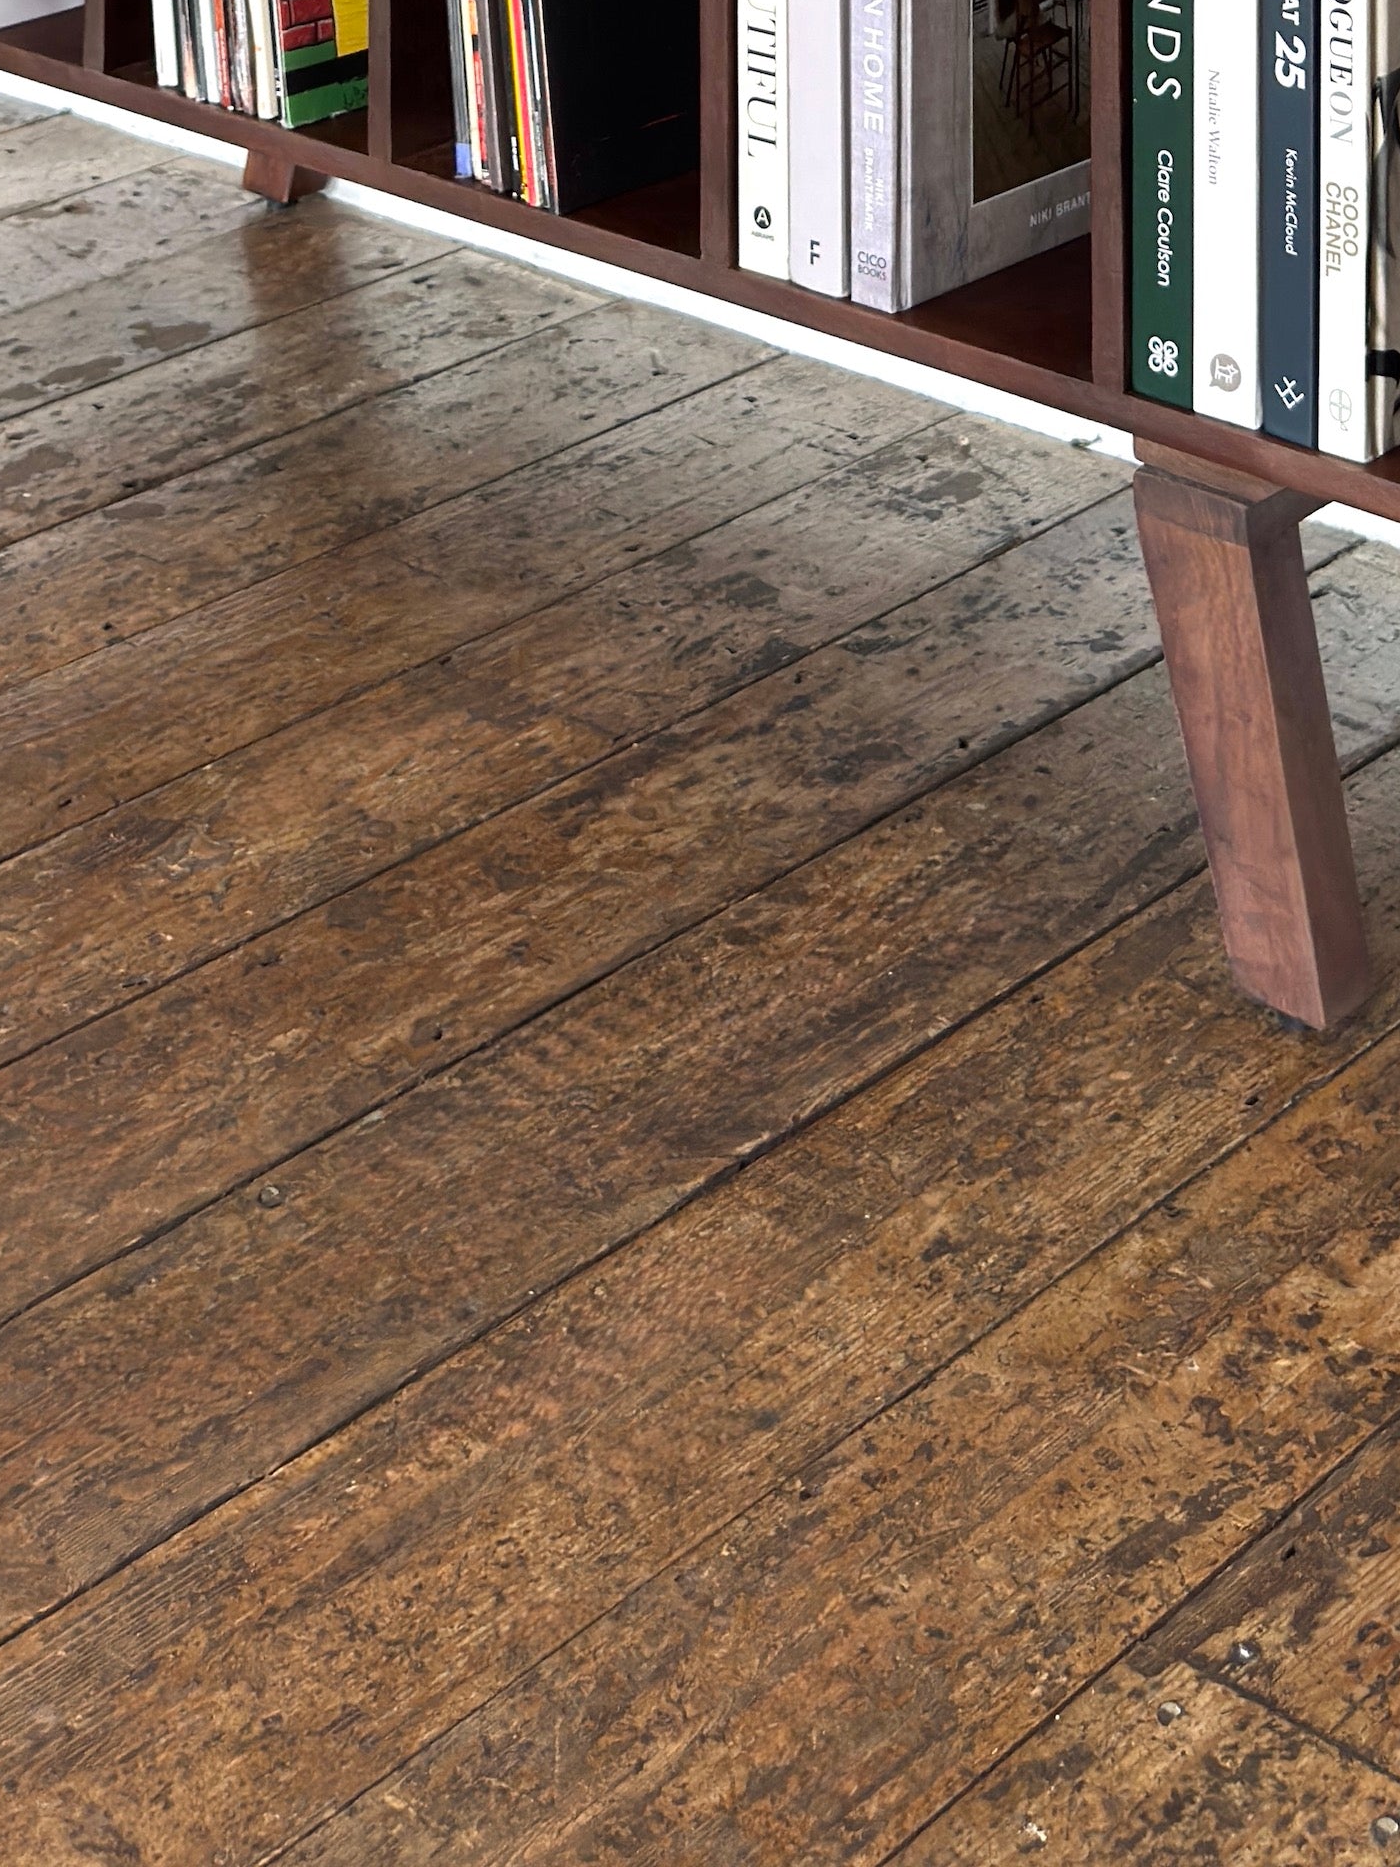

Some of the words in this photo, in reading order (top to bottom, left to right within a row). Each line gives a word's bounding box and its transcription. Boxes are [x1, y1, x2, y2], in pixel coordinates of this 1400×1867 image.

[863, 26, 885, 134] HOME
[1274, 30, 1307, 90] 25
[1207, 69, 1221, 125] Natalie
[1328, 91, 1354, 146] ON
[1157, 149, 1174, 203] Clare
[1207, 129, 1221, 185] Walton
[1284, 148, 1299, 200] Kevin
[874, 179, 884, 206] NIKI
[1029, 207, 1052, 228] NIKI
[1156, 208, 1174, 287] Coulson
[1284, 201, 1299, 256] McCloud
[1324, 181, 1343, 278] CHANEL
[1342, 186, 1360, 257] COCO
[857, 250, 887, 269] CICO
[858, 265, 887, 281] BOOKS
